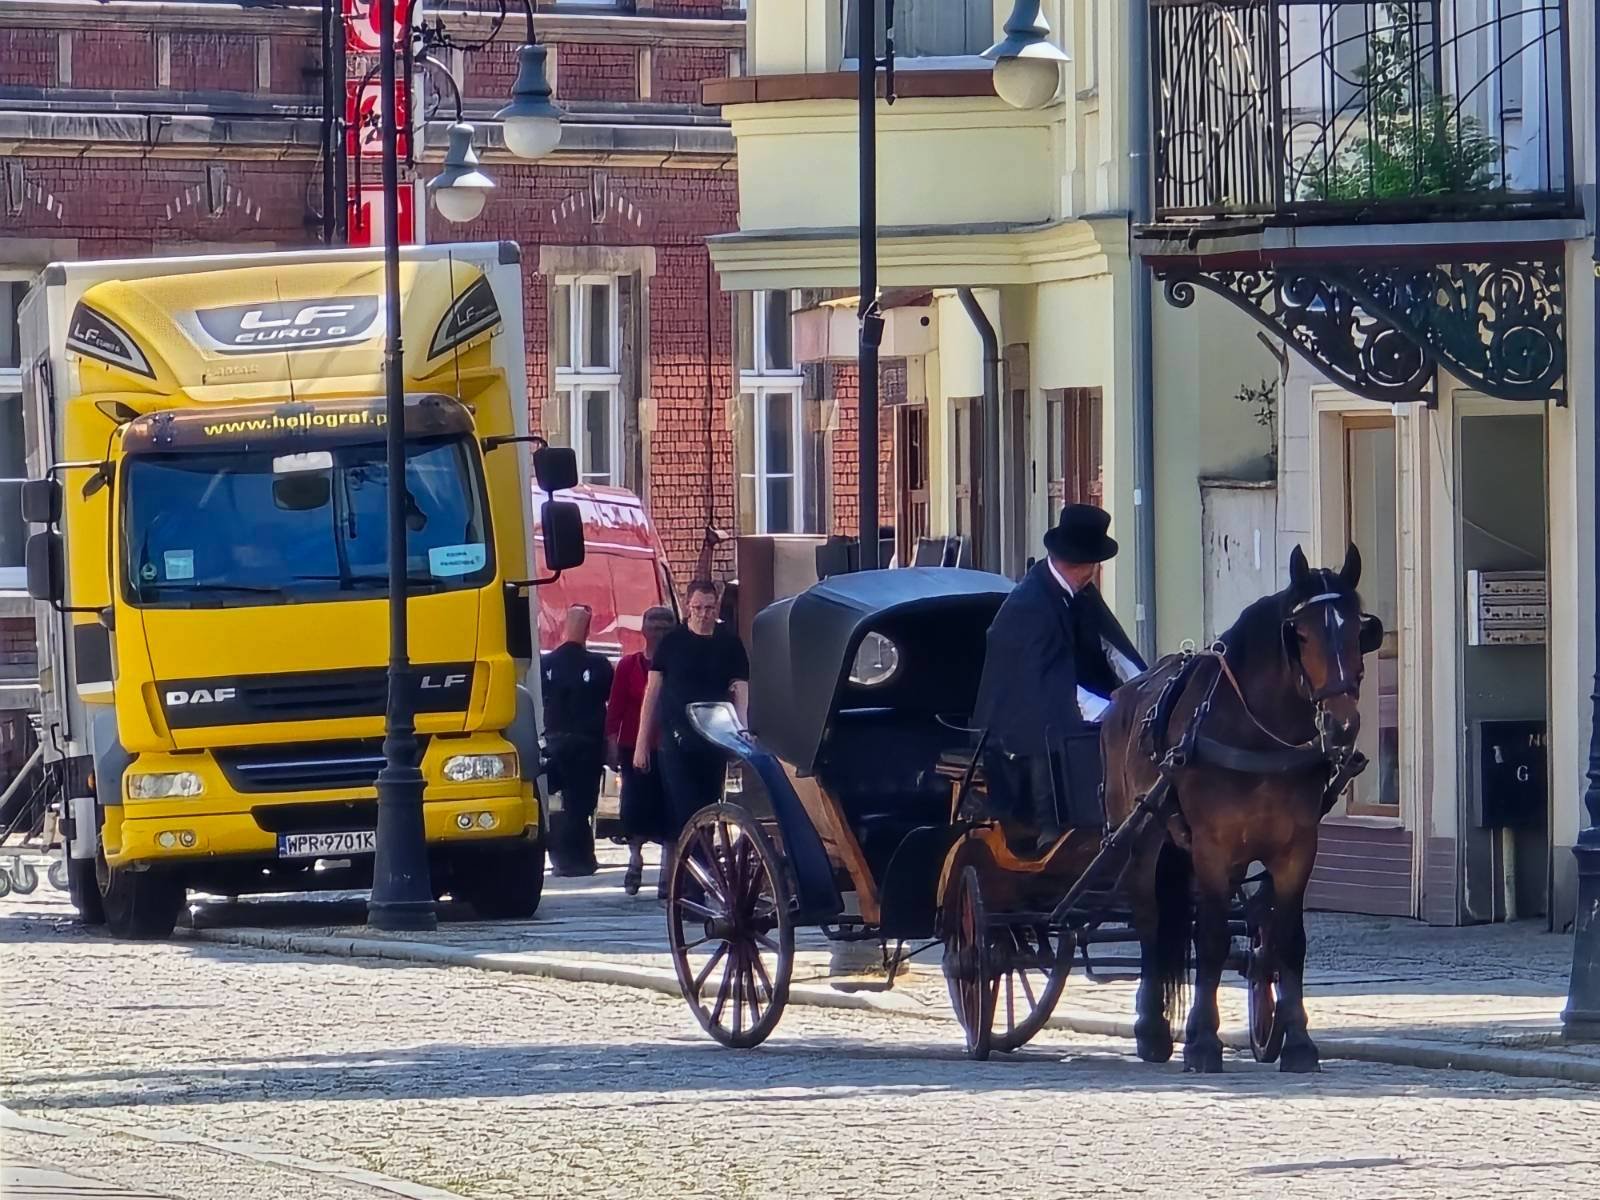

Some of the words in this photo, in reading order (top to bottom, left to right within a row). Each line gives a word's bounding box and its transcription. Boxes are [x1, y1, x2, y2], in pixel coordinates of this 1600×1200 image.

[240, 304, 355, 329] LF
[73, 322, 100, 341] LF
[234, 327, 321, 343] EURO
[327, 325, 347, 336] 6
[420, 674, 467, 689] LF
[166, 688, 236, 706] DAF
